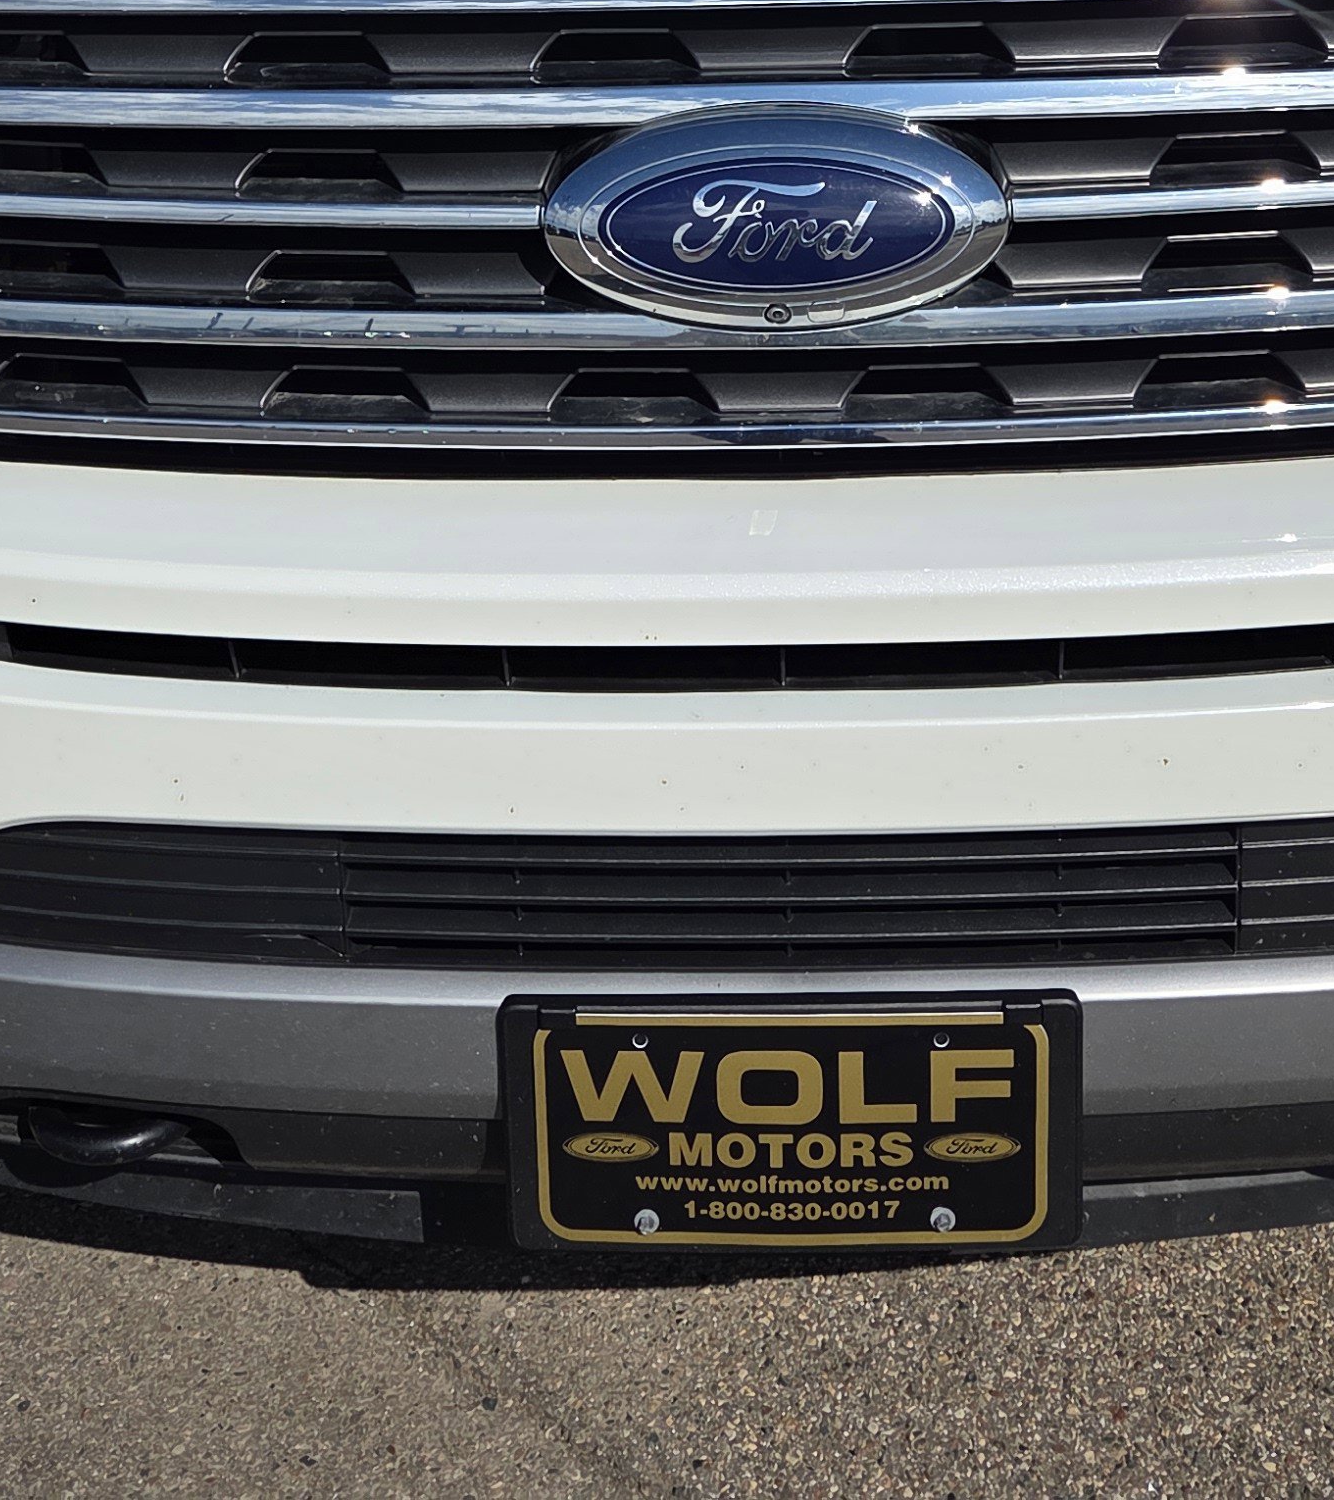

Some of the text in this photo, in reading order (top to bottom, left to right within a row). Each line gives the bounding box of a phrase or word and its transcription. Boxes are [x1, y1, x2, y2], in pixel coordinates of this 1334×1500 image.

[672, 180, 877, 263] Ford
[560, 1048, 1015, 1126] WOLF
[584, 1136, 638, 1157] Ford
[668, 1131, 914, 1169] MOTORS
[944, 1136, 999, 1157] Ford
[635, 1174, 950, 1196] www.wolfmotors.com
[683, 1201, 901, 1221] 1-800-830-0017
